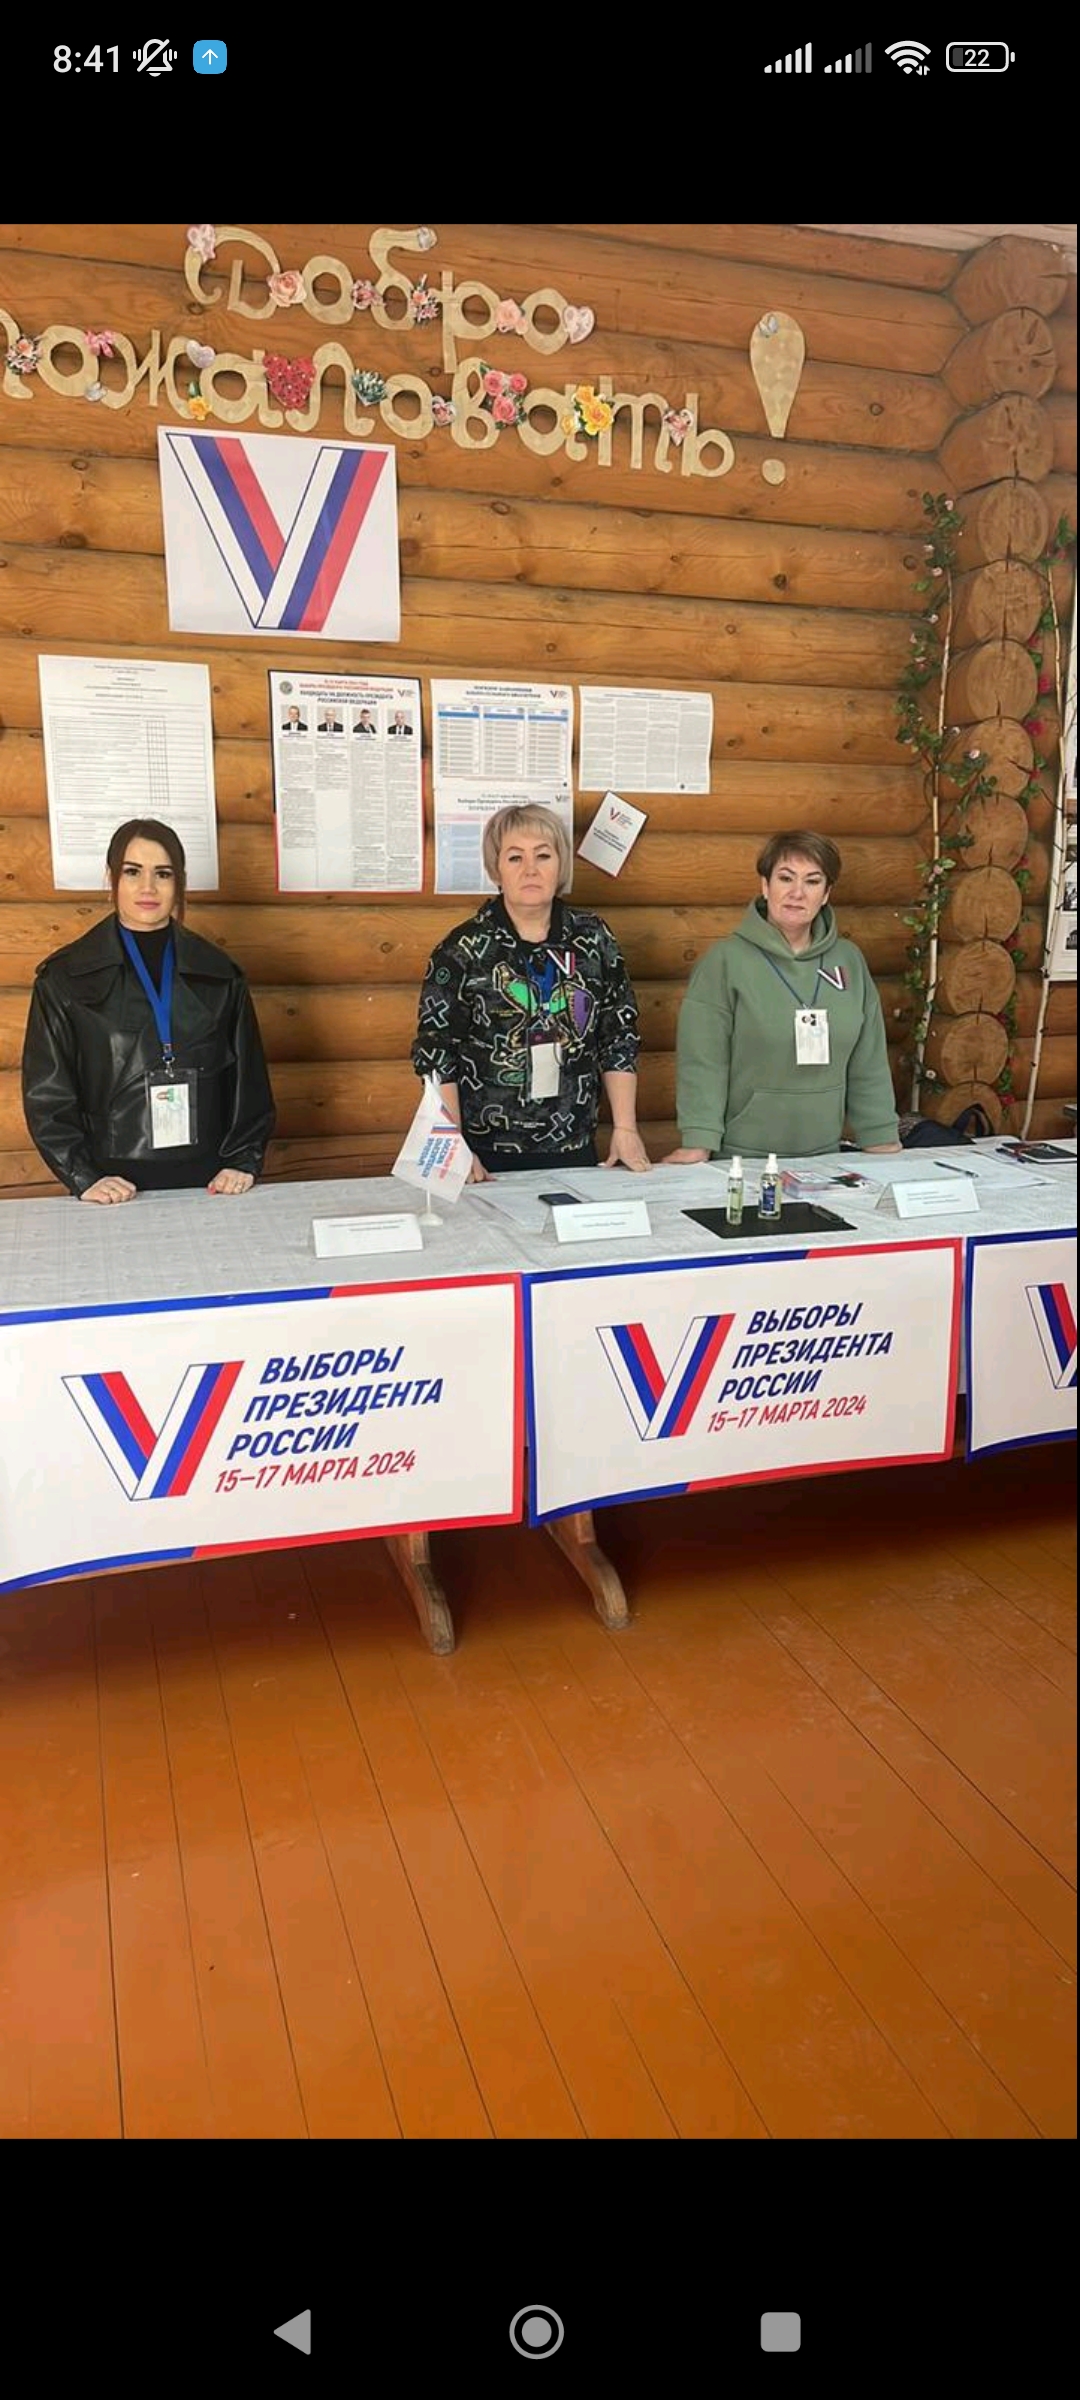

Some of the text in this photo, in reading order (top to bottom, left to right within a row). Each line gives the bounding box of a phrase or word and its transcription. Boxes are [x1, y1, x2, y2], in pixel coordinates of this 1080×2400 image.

[185, 227, 576, 373] Добро
[746, 1302, 864, 1336] ВЫБОРЫ
[259, 1346, 405, 1385] ВЫБОРЫ
[731, 1331, 894, 1371] ПРЕЗИДЕНТА
[243, 1378, 445, 1424] ПРЕЗИДЕНТА
[717, 1369, 823, 1404] РОССИИ
[760, 1400, 819, 1424] МАРТА
[821, 1394, 868, 1418] 2024
[227, 1422, 360, 1462] РОССИИ
[281, 1454, 361, 1487] МАРТА
[362, 1449, 417, 1481] 2024
